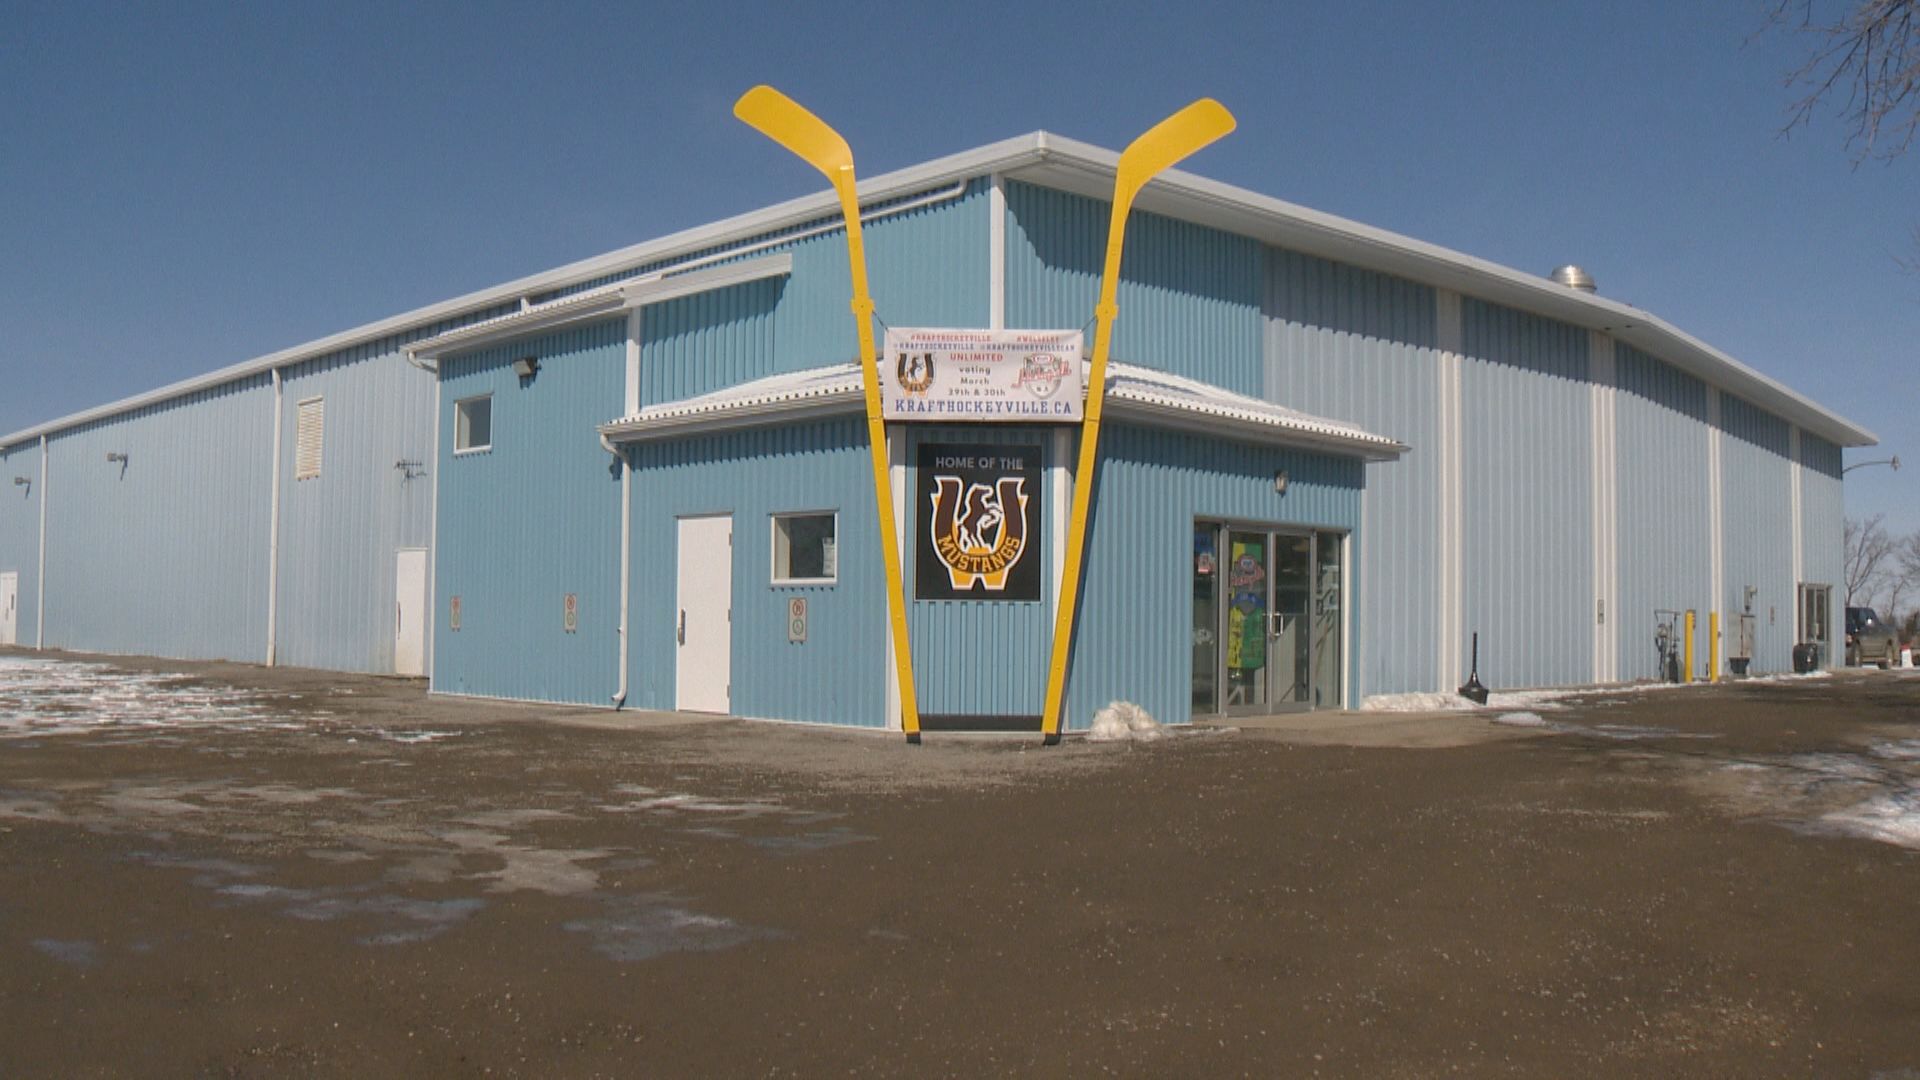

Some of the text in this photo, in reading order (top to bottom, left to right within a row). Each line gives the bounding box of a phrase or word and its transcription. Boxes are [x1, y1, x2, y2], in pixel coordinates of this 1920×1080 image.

[949, 353, 1003, 362] UNLIMITED
[959, 366, 991, 376] voting
[960, 377, 990, 385] March
[948, 388, 1006, 396] 29th & 30th
[895, 399, 1073, 414] KRAFTHOCKEYVILLE.CA
[935, 457, 1024, 470] HOME OF THE
[938, 535, 1021, 573] MUSTANGS
